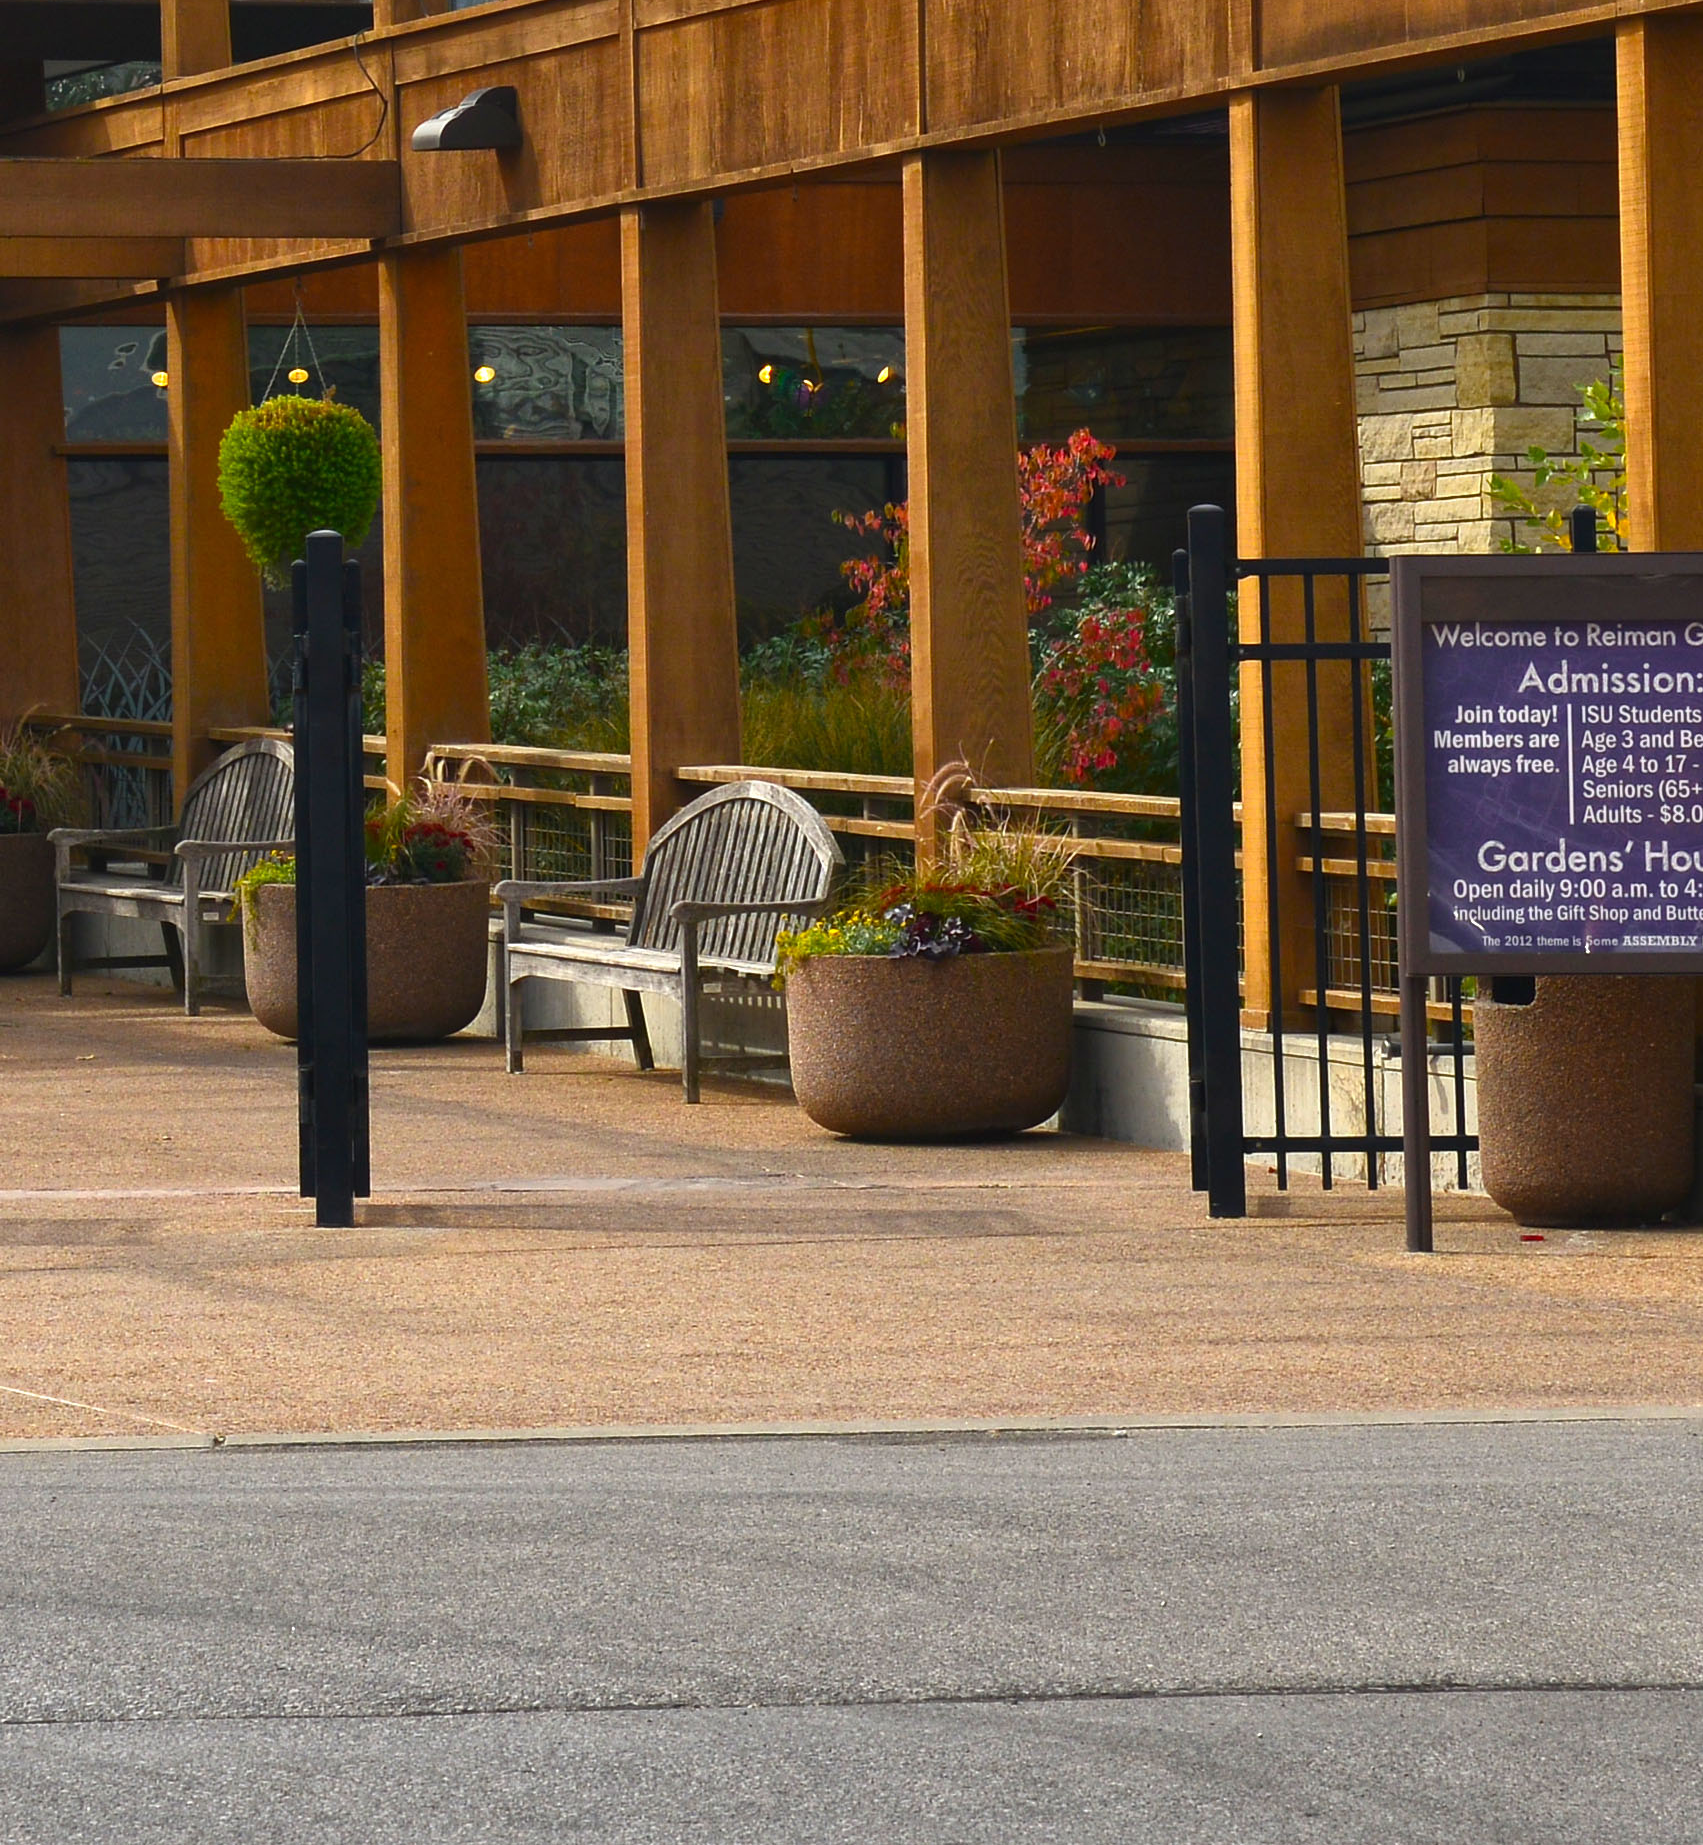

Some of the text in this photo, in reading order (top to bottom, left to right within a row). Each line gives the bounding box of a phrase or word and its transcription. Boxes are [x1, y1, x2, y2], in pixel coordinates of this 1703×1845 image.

[1432, 622, 1547, 647] Welcome
[1555, 627, 1579, 647] to
[1587, 623, 1676, 647] Reiman
[1518, 659, 1703, 694] Admission:
[1454, 705, 1558, 728] Join today!
[1581, 705, 1613, 724] ISU
[1618, 705, 1702, 724] Students
[1434, 730, 1560, 749] Members are
[1581, 729, 1617, 753] Age
[1621, 729, 1634, 749] 3
[1639, 729, 1675, 749] and
[1447, 754, 1560, 778] always free.
[1582, 754, 1618, 778] Age
[1622, 754, 1636, 773] 4
[1639, 755, 1659, 774] to
[1665, 754, 1687, 773] 17
[1582, 779, 1654, 799] Seniors
[1582, 804, 1643, 824] Adults
[1453, 879, 1504, 903] Open
[1509, 878, 1556, 903] daily
[1560, 878, 1606, 899] 9:00
[1611, 879, 1654, 899] a.m.
[1658, 879, 1679, 899] to
[1452, 904, 1526, 925] including
[1527, 904, 1554, 921] the
[1556, 904, 1586, 921] Gift
[1588, 904, 1629, 924] Shop
[1632, 904, 1662, 921] and
[1482, 935, 1501, 947] The
[1504, 935, 1533, 947] 2012
[1536, 935, 1570, 947] theme
[1572, 936, 1582, 947] is
[1585, 934, 1619, 947] Some
[1622, 934, 1699, 947] ASSEMBLY
